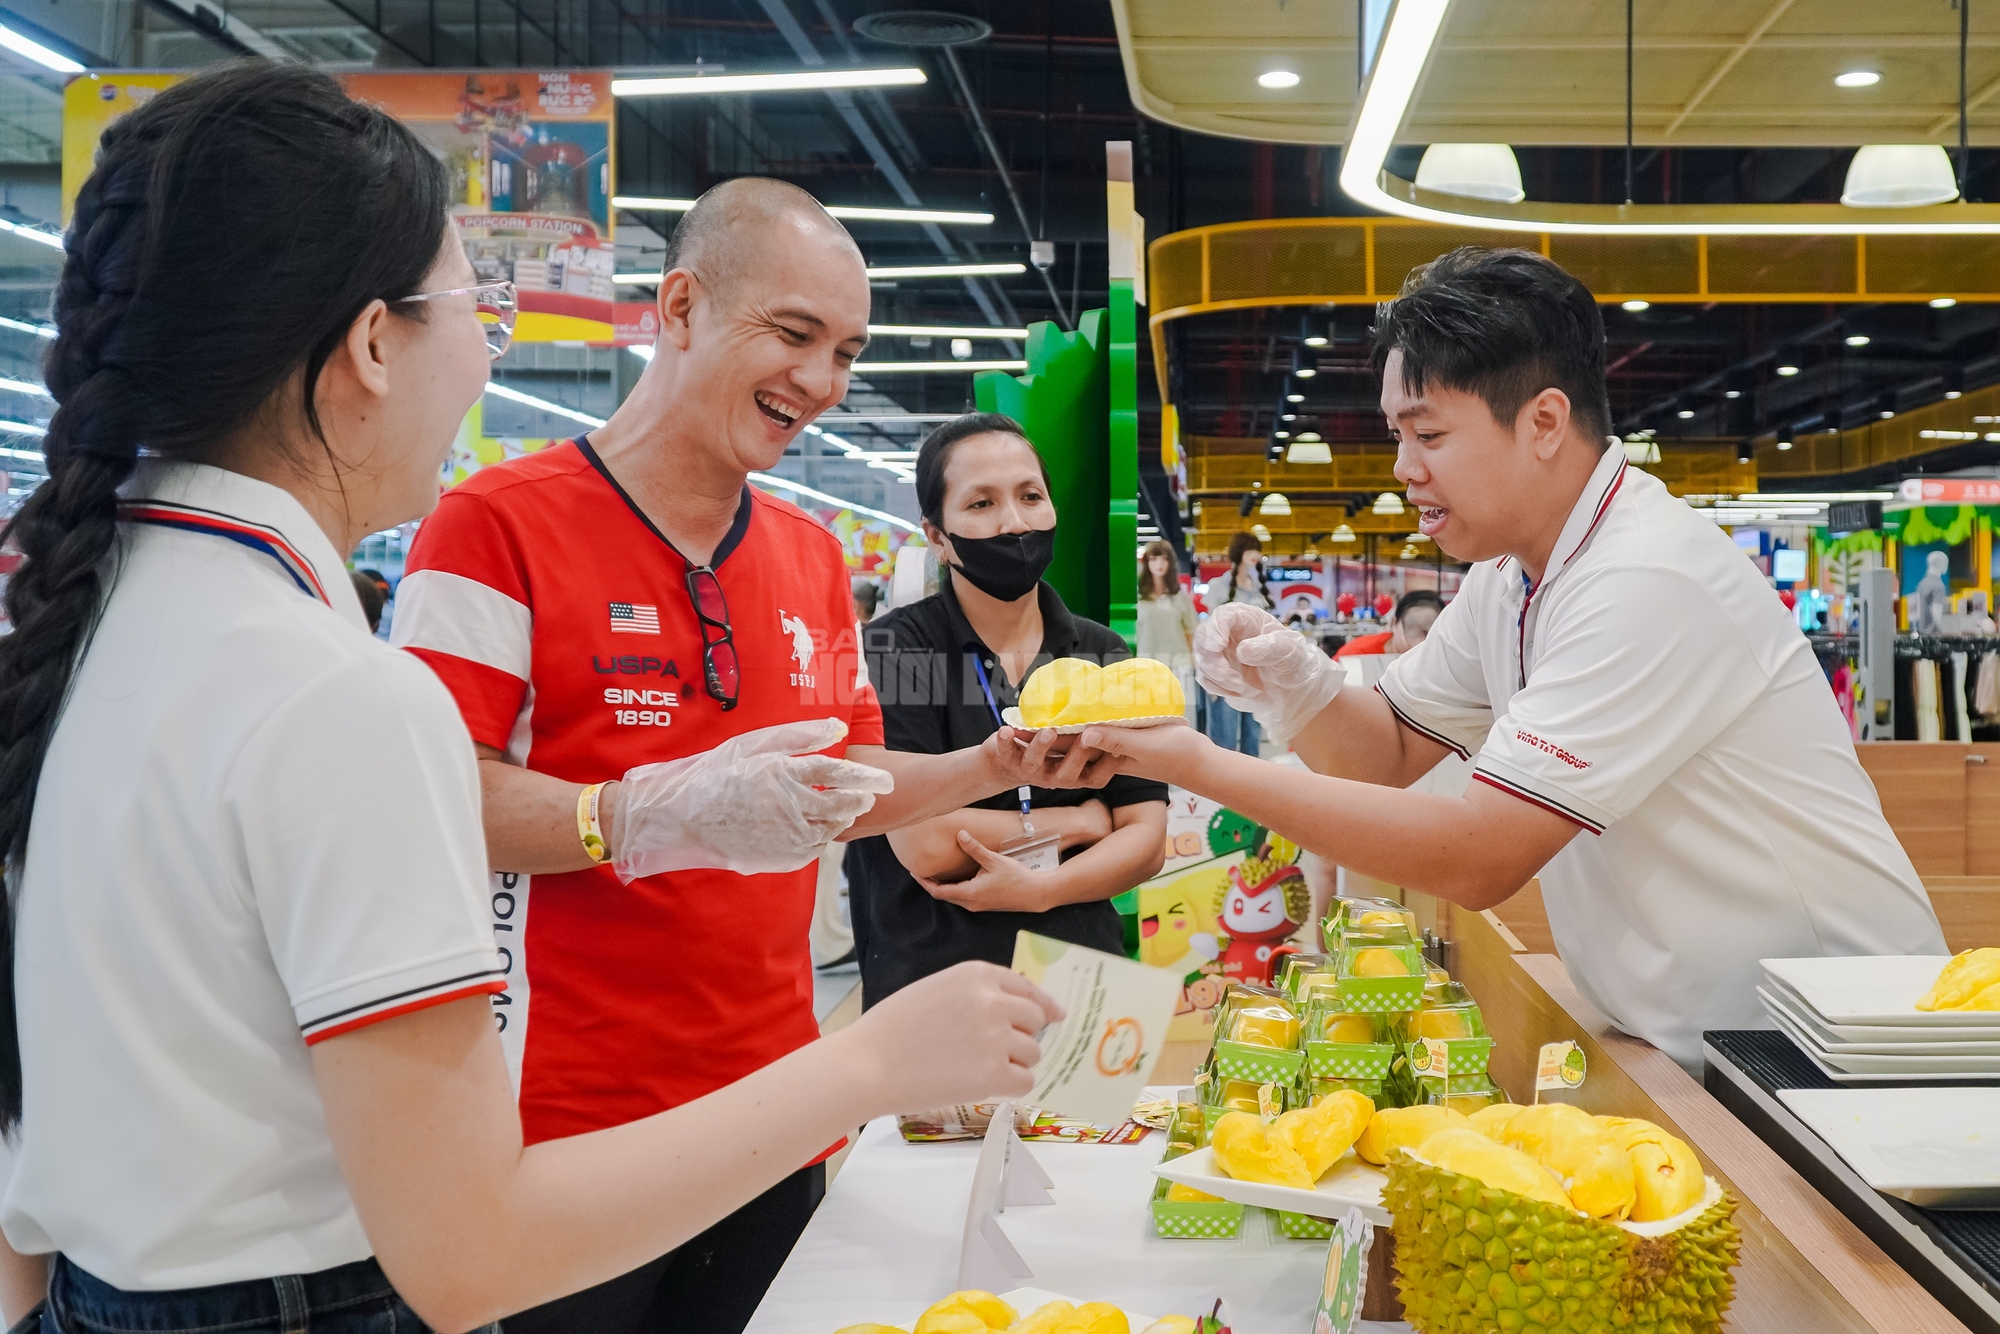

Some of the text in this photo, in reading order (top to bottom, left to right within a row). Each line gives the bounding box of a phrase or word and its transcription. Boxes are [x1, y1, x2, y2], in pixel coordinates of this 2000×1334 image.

[465, 216, 527, 229] POPCORN
[529, 218, 584, 234] STATION
[592, 655, 680, 679] USPA
[603, 687, 680, 707] SINCE
[614, 709, 672, 727] 1890
